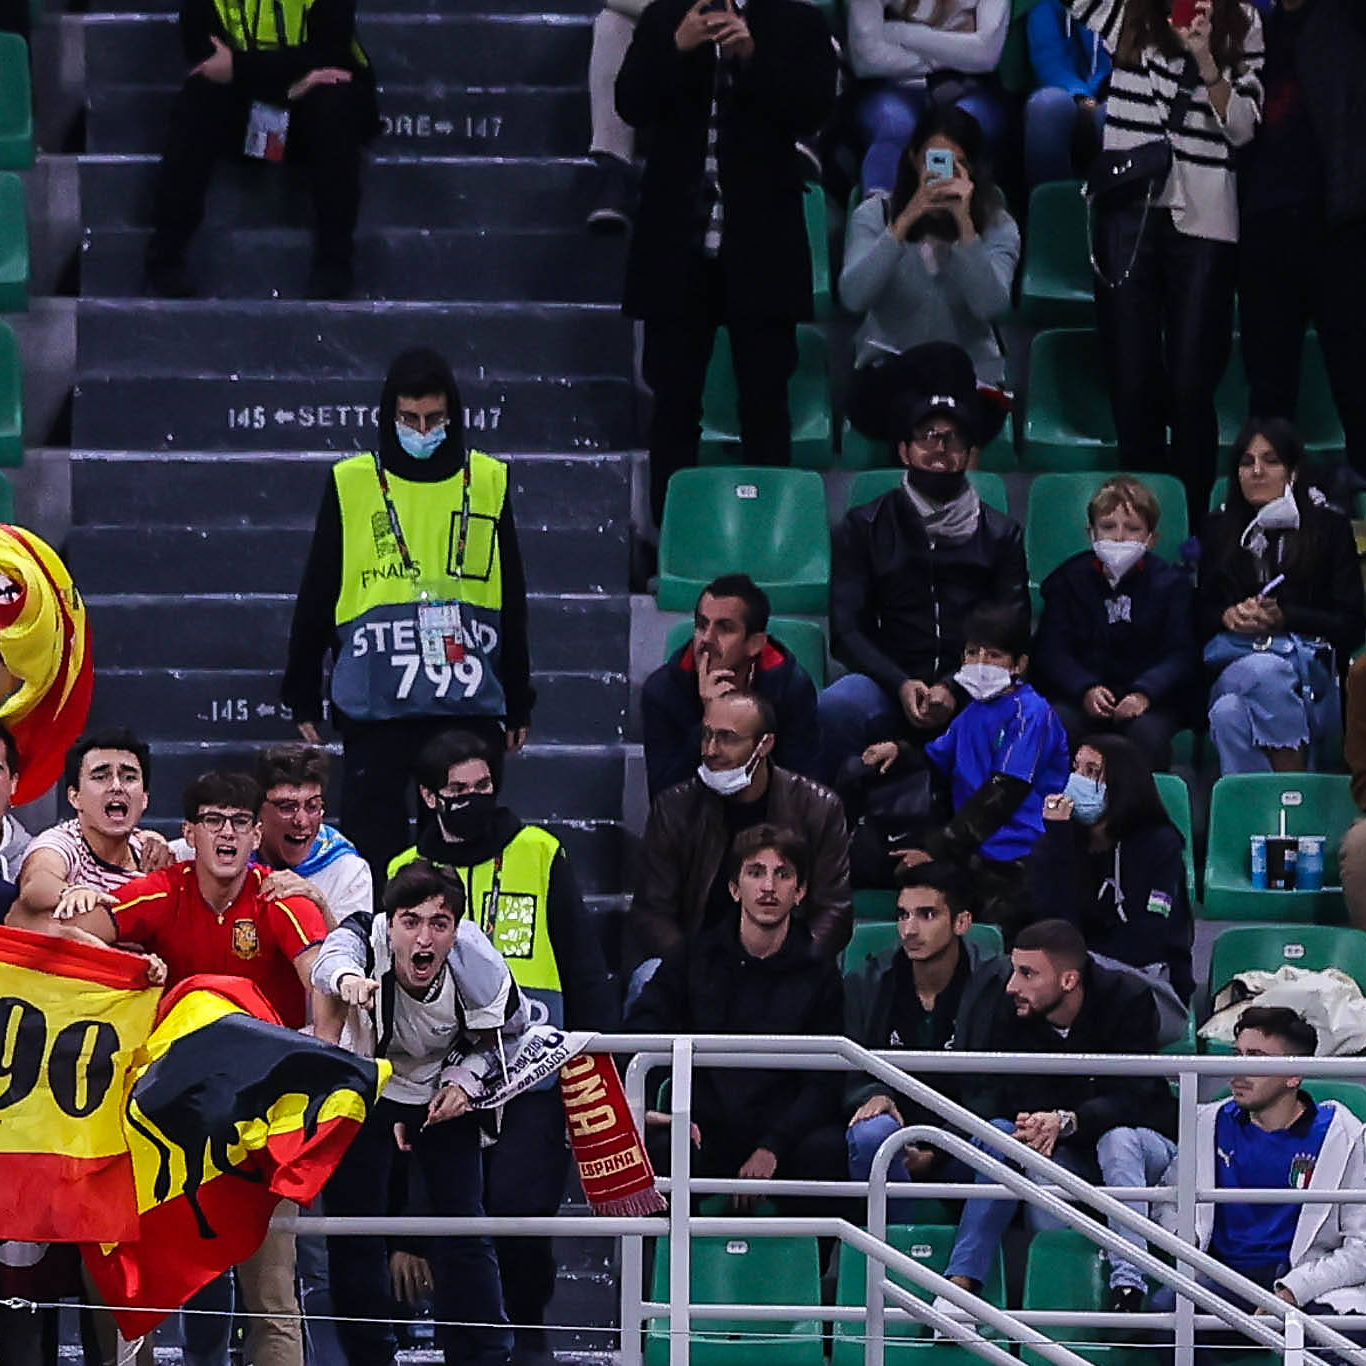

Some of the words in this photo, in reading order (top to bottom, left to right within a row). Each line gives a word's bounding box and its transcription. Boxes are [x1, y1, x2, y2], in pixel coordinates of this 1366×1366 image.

[465, 116, 503, 137] 147
[228, 406, 265, 429] 145
[463, 406, 502, 431] 147
[390, 654, 483, 699] 799
[212, 700, 249, 721] 145
